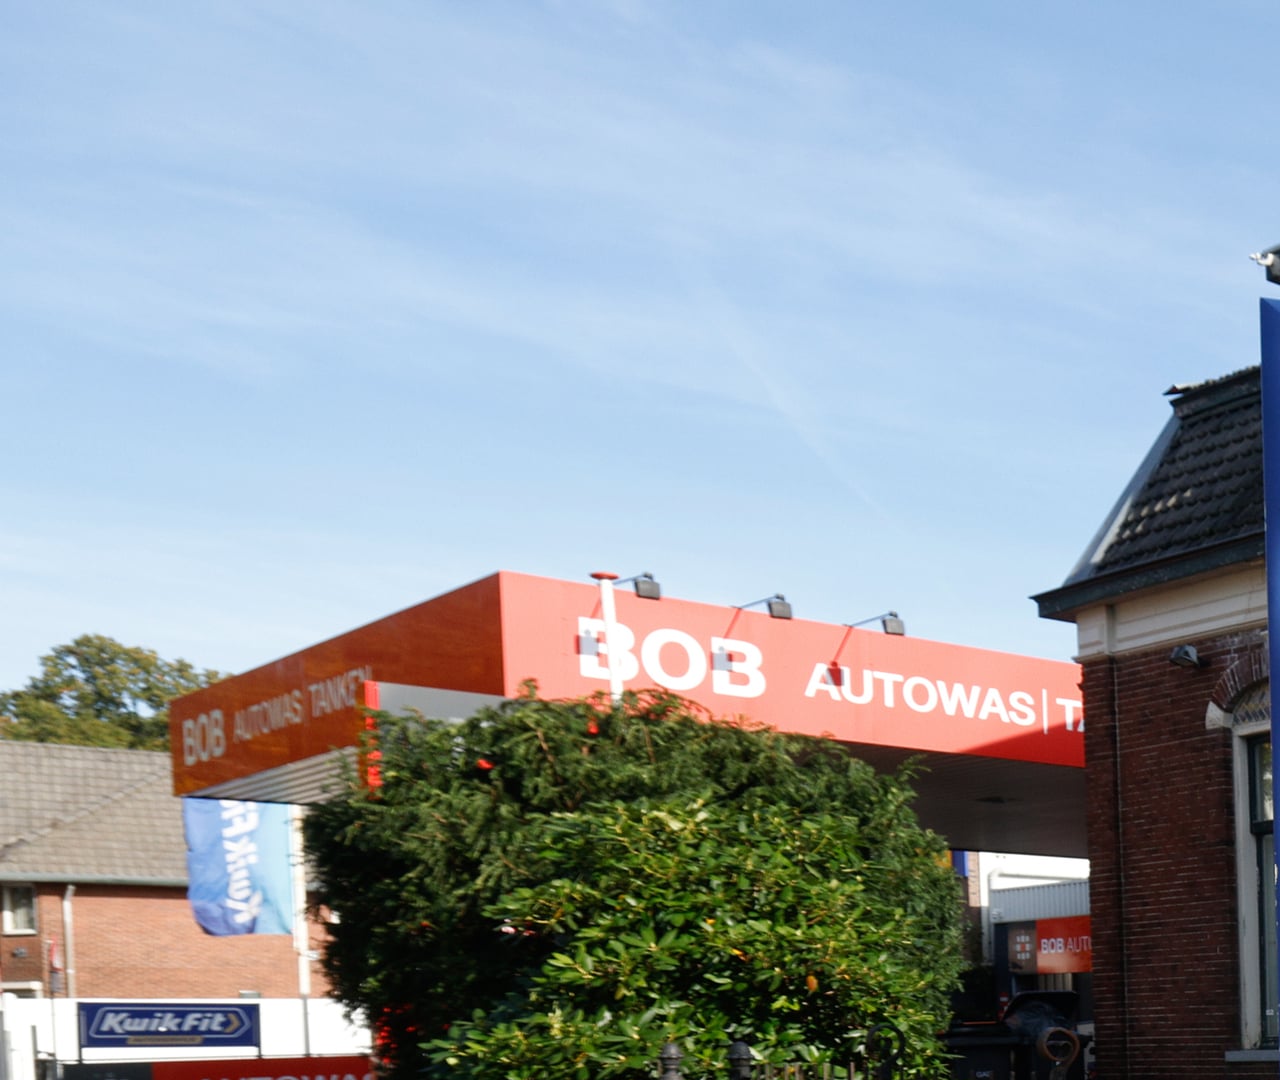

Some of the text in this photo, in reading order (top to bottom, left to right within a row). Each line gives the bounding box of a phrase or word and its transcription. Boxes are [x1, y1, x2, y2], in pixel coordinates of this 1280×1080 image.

[578, 616, 767, 698] BOB
[804, 662, 1037, 726] AUTOWAS
[1055, 697, 1085, 732] T
[182, 708, 226, 766] BOB
[1041, 938, 1064, 954] BOB
